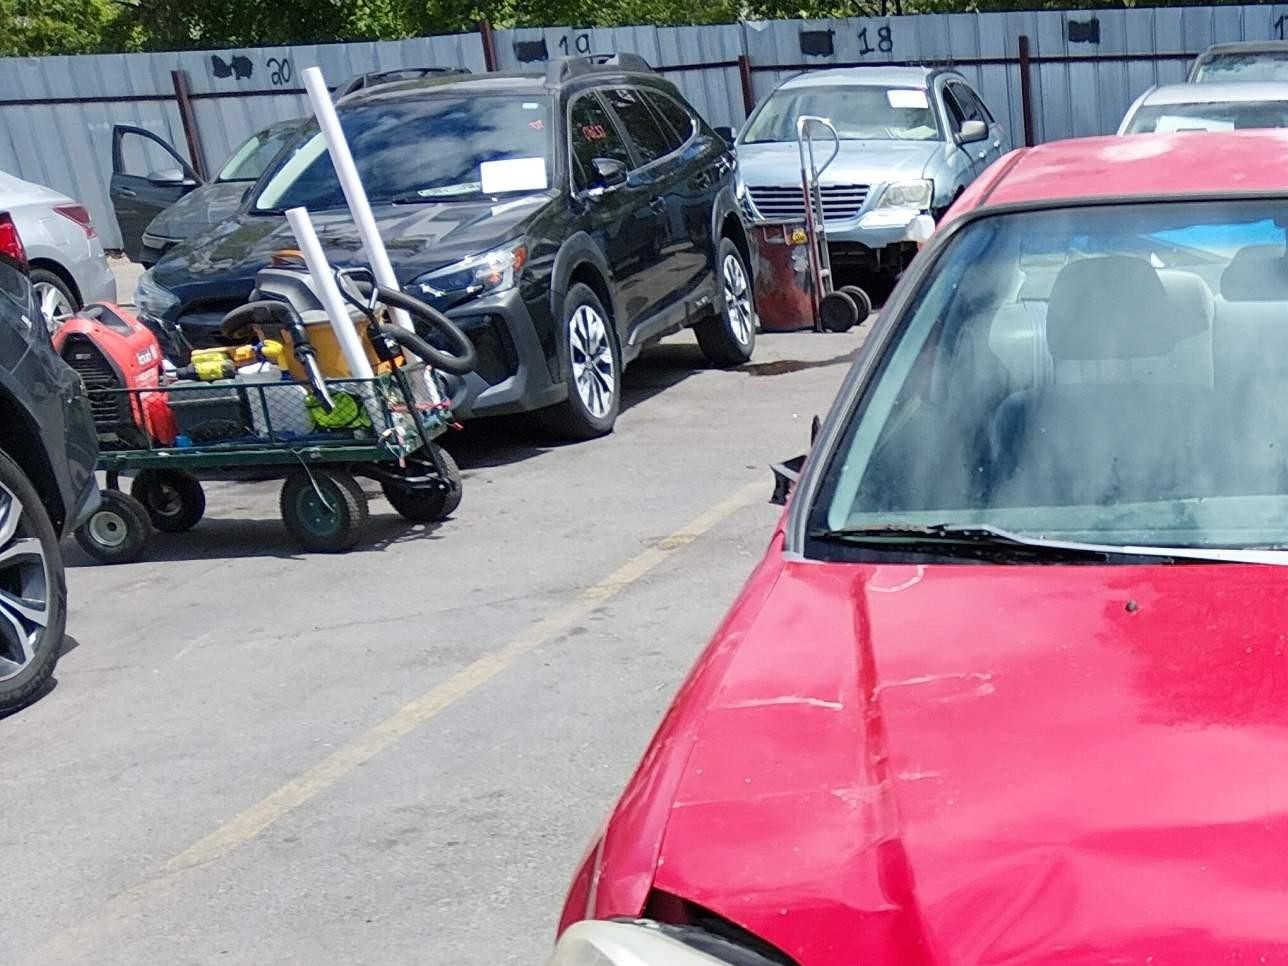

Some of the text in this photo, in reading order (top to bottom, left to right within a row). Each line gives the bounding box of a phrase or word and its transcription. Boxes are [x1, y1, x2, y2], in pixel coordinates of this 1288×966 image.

[559, 33, 594, 65] 19
[858, 26, 893, 56] 18
[266, 57, 291, 86] 20
